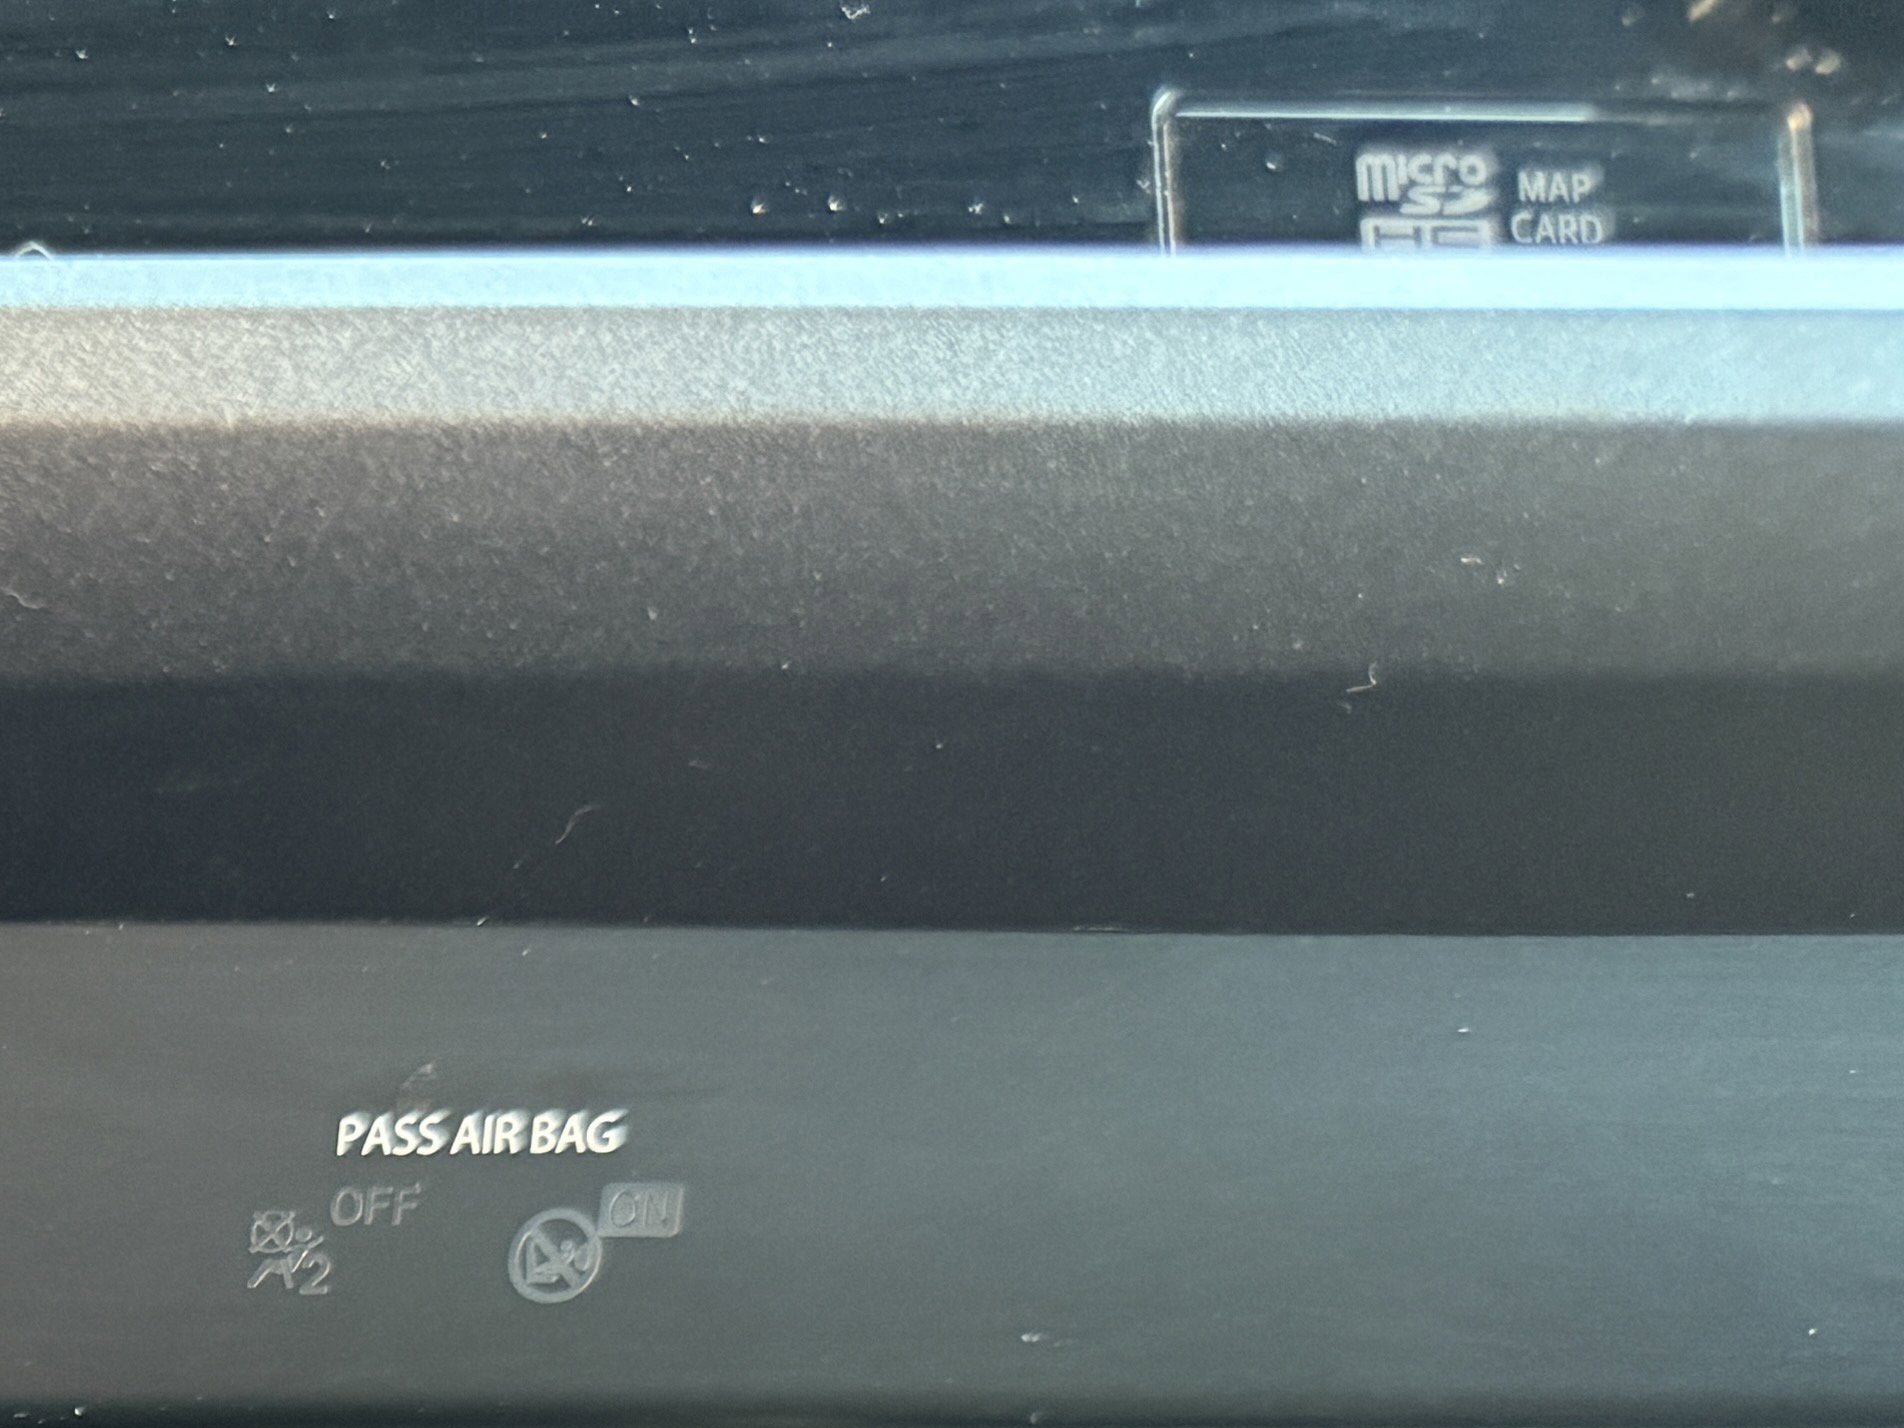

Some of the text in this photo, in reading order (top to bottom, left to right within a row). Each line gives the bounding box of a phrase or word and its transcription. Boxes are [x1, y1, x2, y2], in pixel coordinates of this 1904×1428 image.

[1519, 171, 1595, 203] MAP
[1510, 213, 1603, 244] CARD
[336, 1110, 624, 1156] PASS AIR BAG
[330, 1182, 422, 1226] OFF
[608, 1190, 672, 1226] ON
